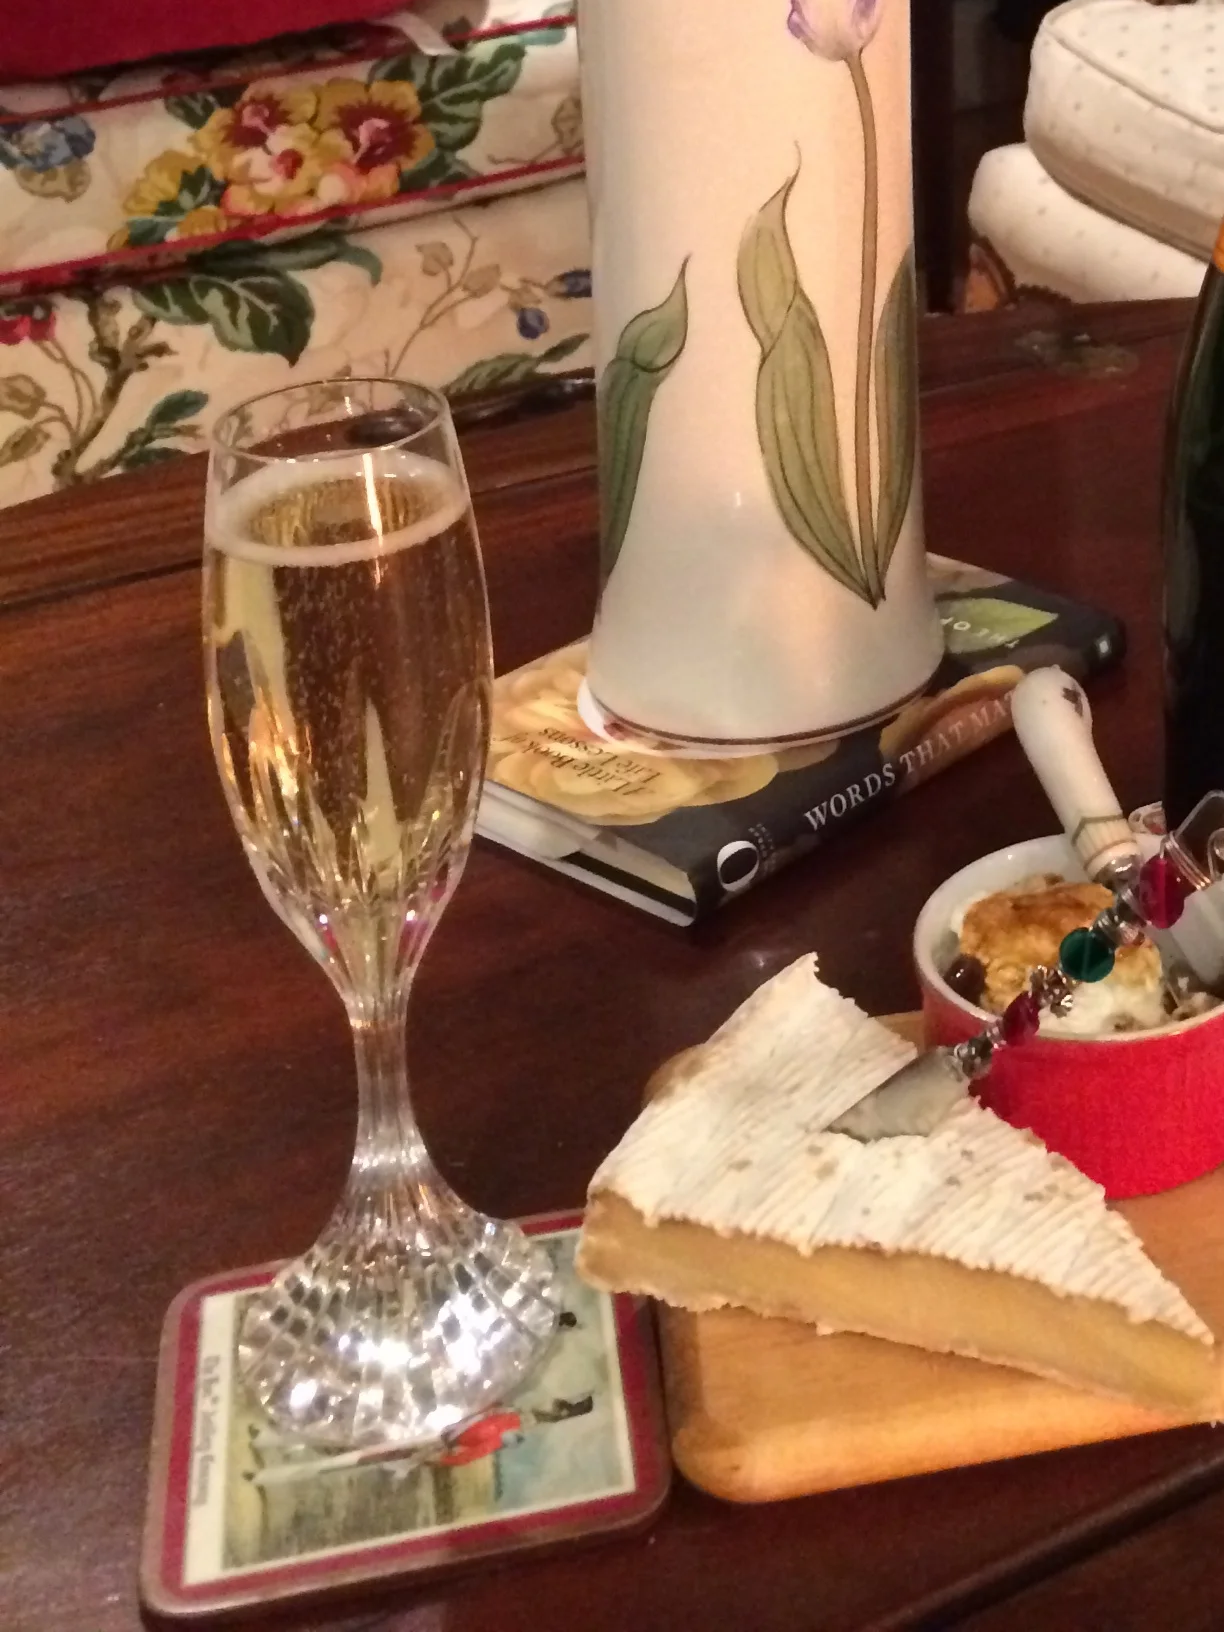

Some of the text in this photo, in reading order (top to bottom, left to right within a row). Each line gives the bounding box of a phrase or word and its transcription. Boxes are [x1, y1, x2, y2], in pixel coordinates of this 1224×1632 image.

[522, 741, 575, 768] Book
[538, 727, 661, 784] Life Lessons
[803, 762, 896, 831] WORDS
[900, 720, 964, 773] THAT
[573, 762, 631, 792] Little
